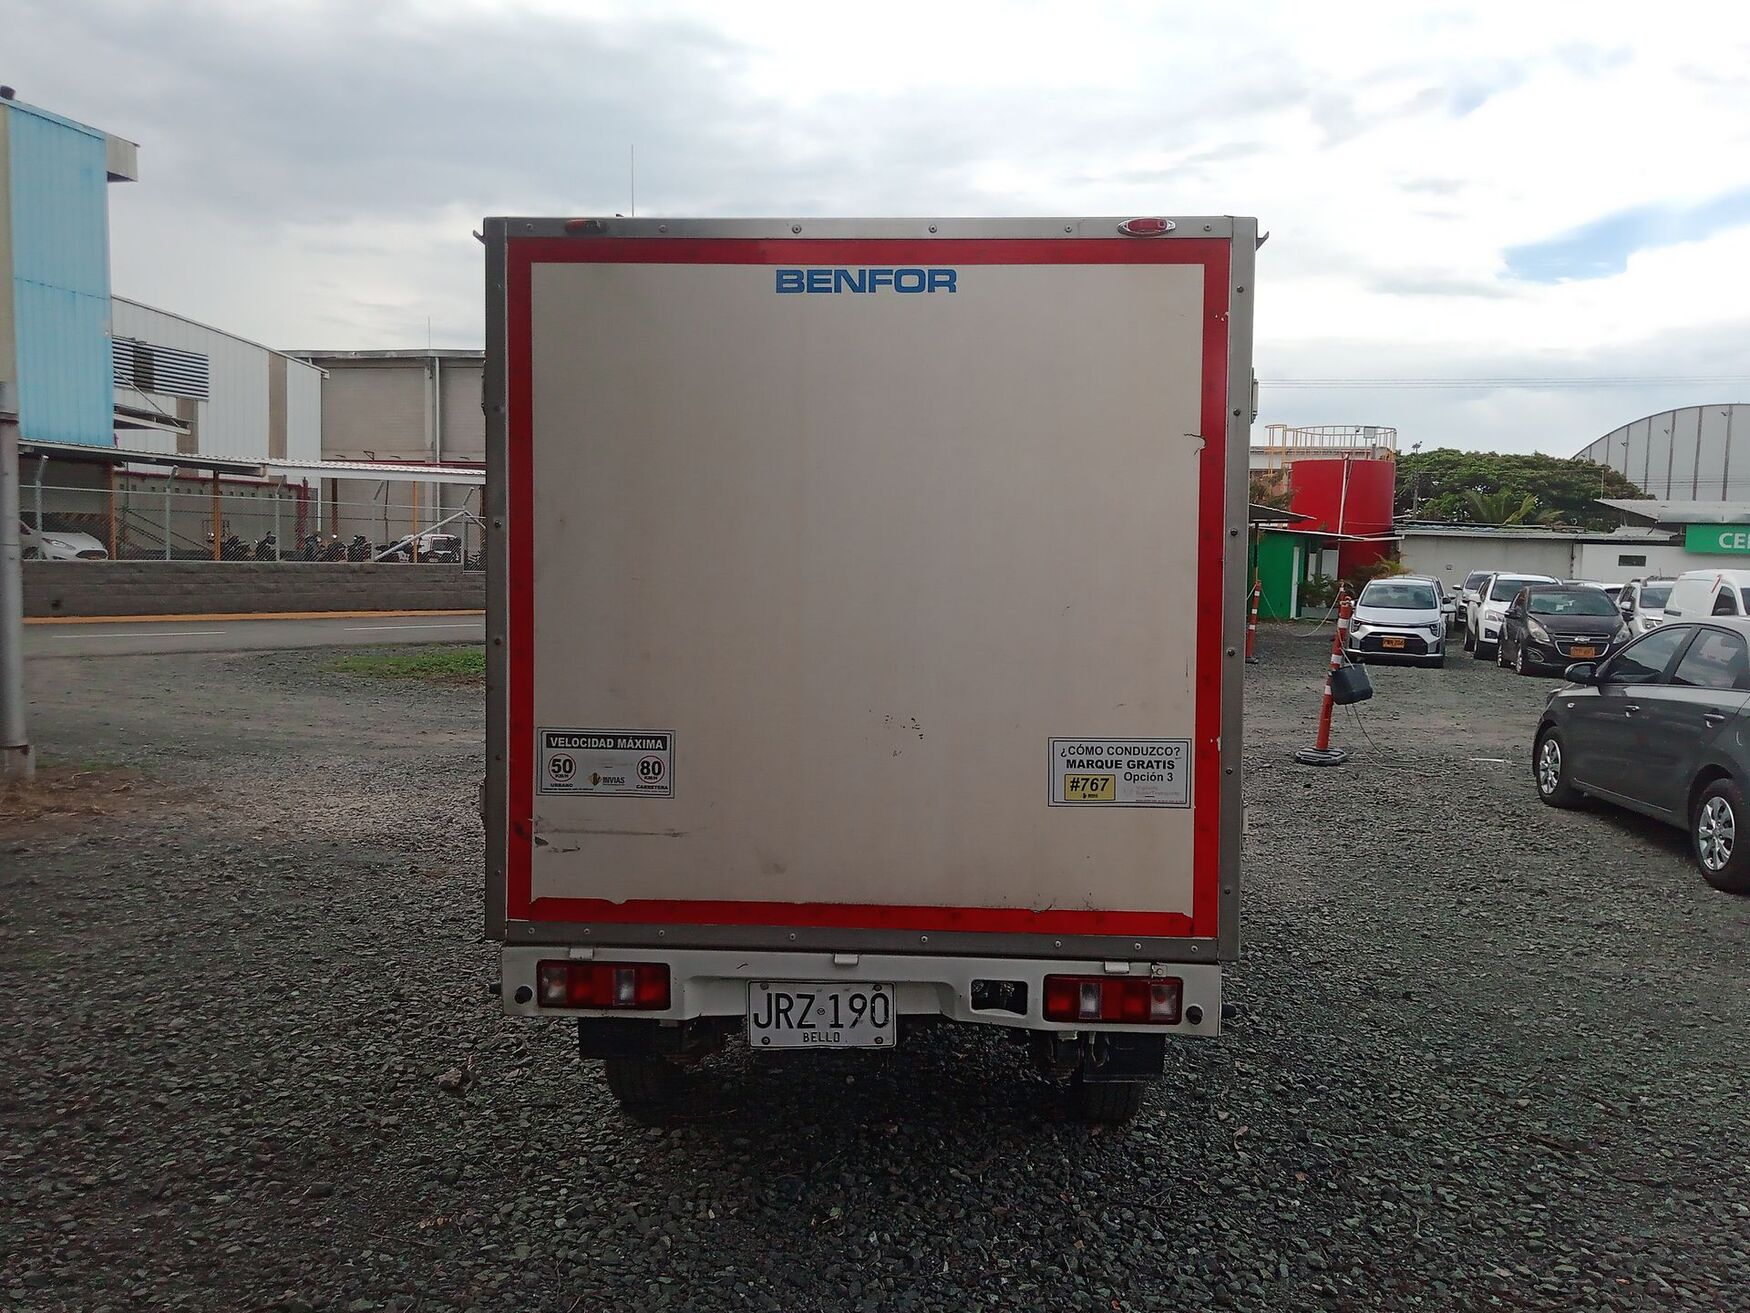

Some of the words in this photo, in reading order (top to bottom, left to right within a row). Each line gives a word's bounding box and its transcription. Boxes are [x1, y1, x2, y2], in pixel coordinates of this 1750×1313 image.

[776, 268, 957, 294] BENFOR
[550, 737, 614, 749] VELOCIDAD
[617, 737, 663, 750] MÁXIMA
[1060, 744, 1104, 757] ¿CÓMO
[1106, 746, 1181, 757] CONDUZCO?
[551, 758, 573, 774] 50
[640, 761, 662, 777] 80
[1066, 759, 1123, 770] MARQUE
[1126, 759, 1176, 770] GRATIS
[1123, 771, 1164, 783] Opción
[1166, 772, 1174, 782] 3
[1070, 777, 1110, 792] #767
[753, 992, 816, 1029] JRZ
[828, 992, 890, 1029] 190
[802, 1031, 840, 1043] BELLO
